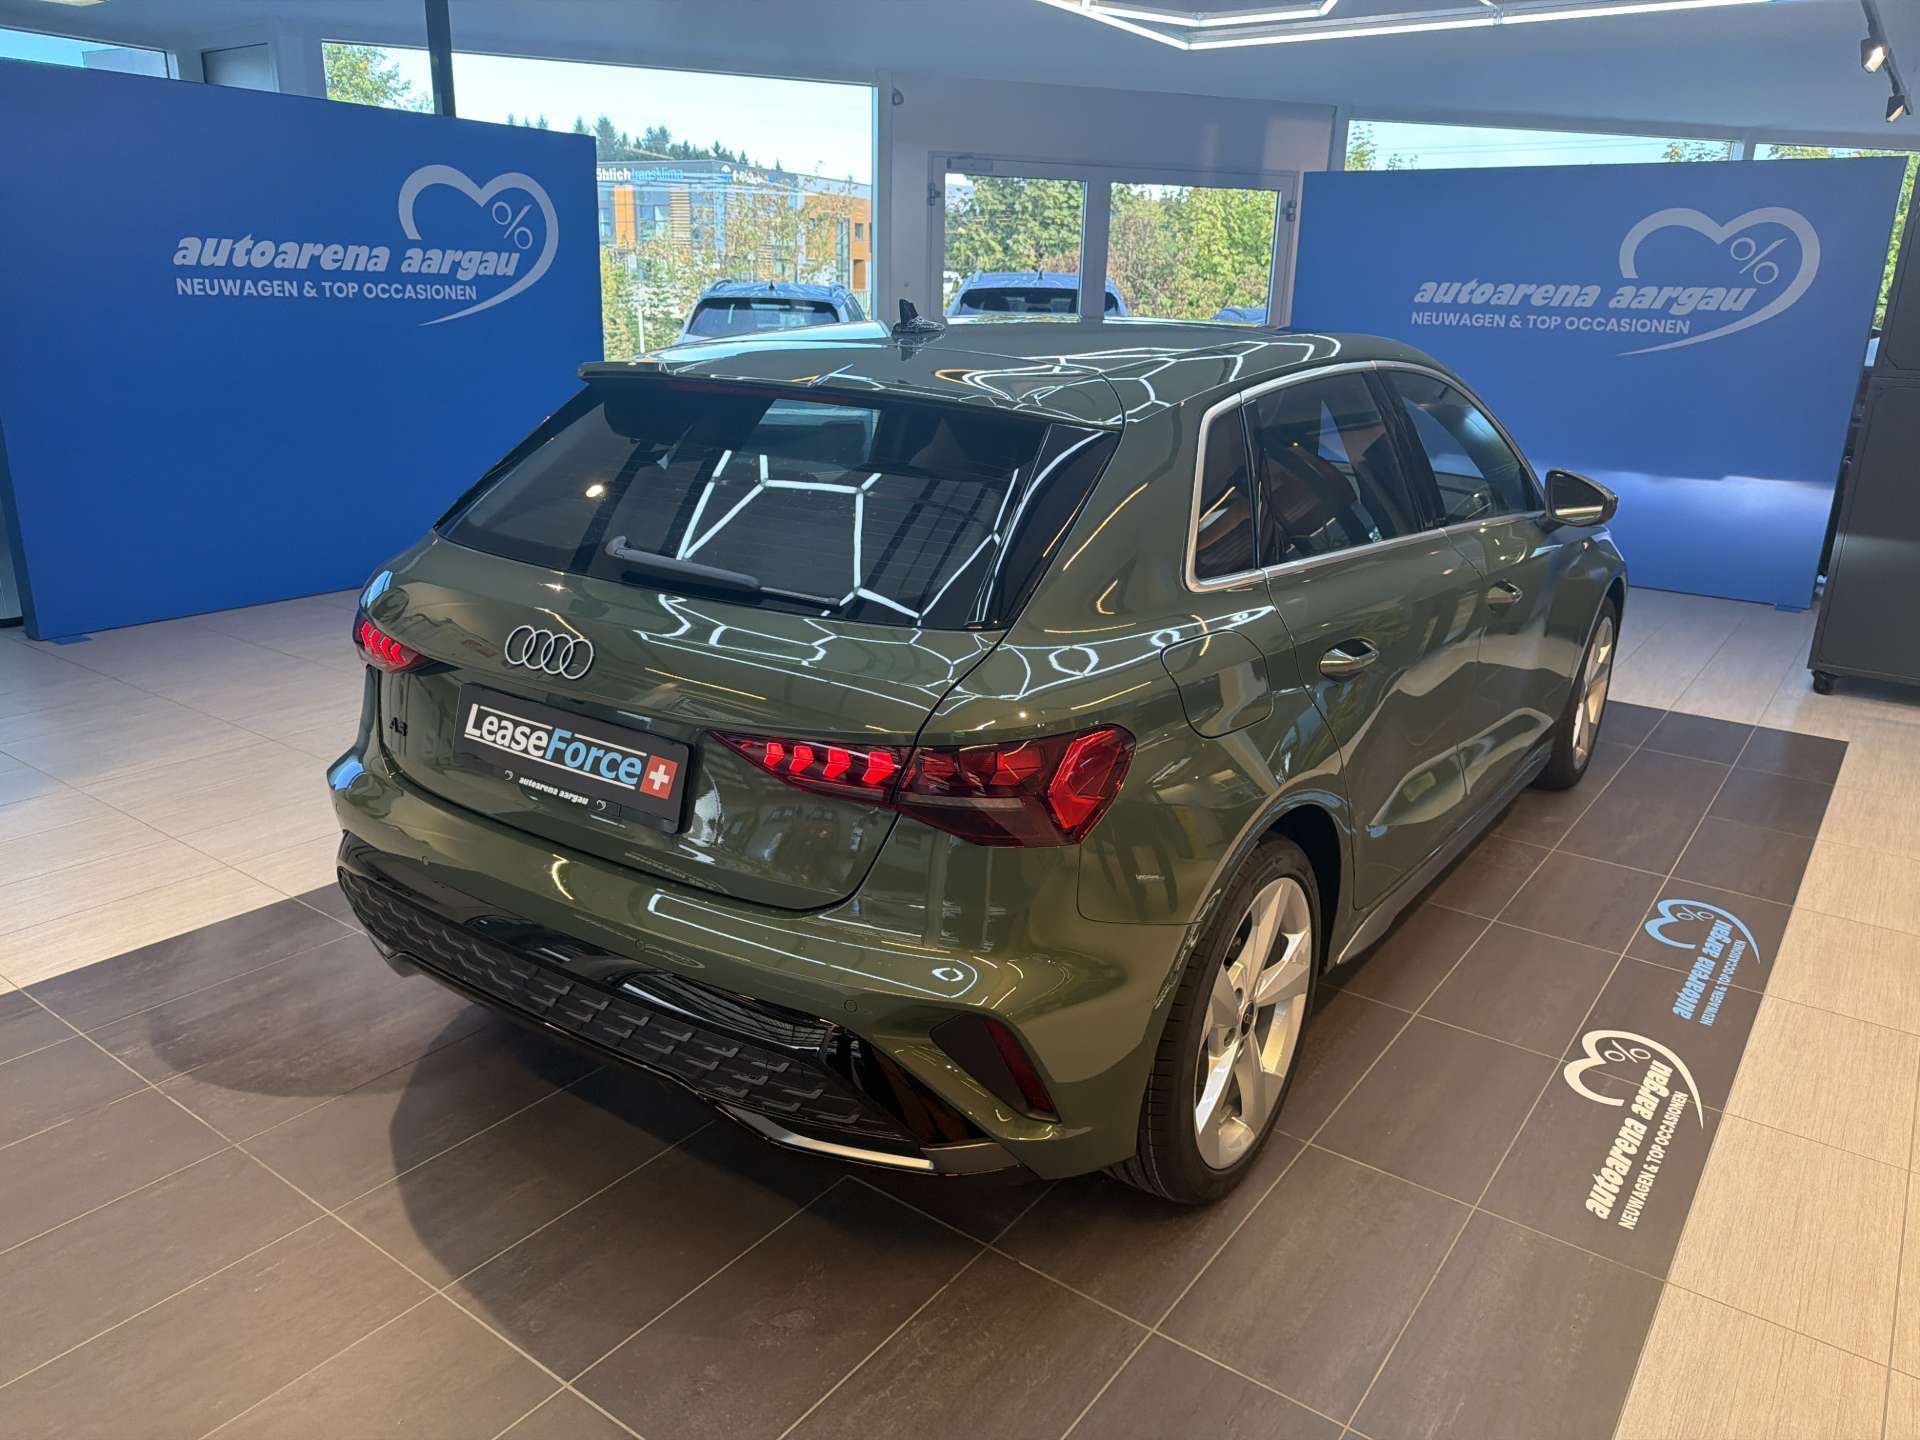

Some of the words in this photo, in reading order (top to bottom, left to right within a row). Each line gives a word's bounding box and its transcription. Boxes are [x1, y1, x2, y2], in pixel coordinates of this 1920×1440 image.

[173, 234, 390, 273] autoarena
[400, 247, 521, 281] aargau
[176, 278, 298, 297] NEUWAGEN
[303, 282, 318, 299] &
[321, 281, 359, 299] TOP
[363, 283, 478, 301] OCCASIONEN
[1414, 278, 1601, 308] autoarena
[1609, 284, 1757, 316] aargau
[1411, 311, 1505, 328] NEUWAGEN
[1509, 314, 1522, 329] &
[1527, 315, 1562, 330] TOP
[1565, 317, 1690, 335] OCCASIONEN
[464, 703, 642, 785] LeaseForce
[518, 777, 559, 795] autoarena
[558, 790, 590, 806] aargau
[1672, 956, 1716, 1020] autoarena
[1702, 919, 1733, 958] aargau
[1585, 1117, 1648, 1220] autoarena
[1632, 1059, 1673, 1121] aargau
[1655, 1090, 1689, 1147] OCCASIONEN
[1643, 1162, 1660, 1175] &
[1646, 1143, 1666, 1164] TOP
[1618, 1170, 1656, 1230] NEUWAGEN
